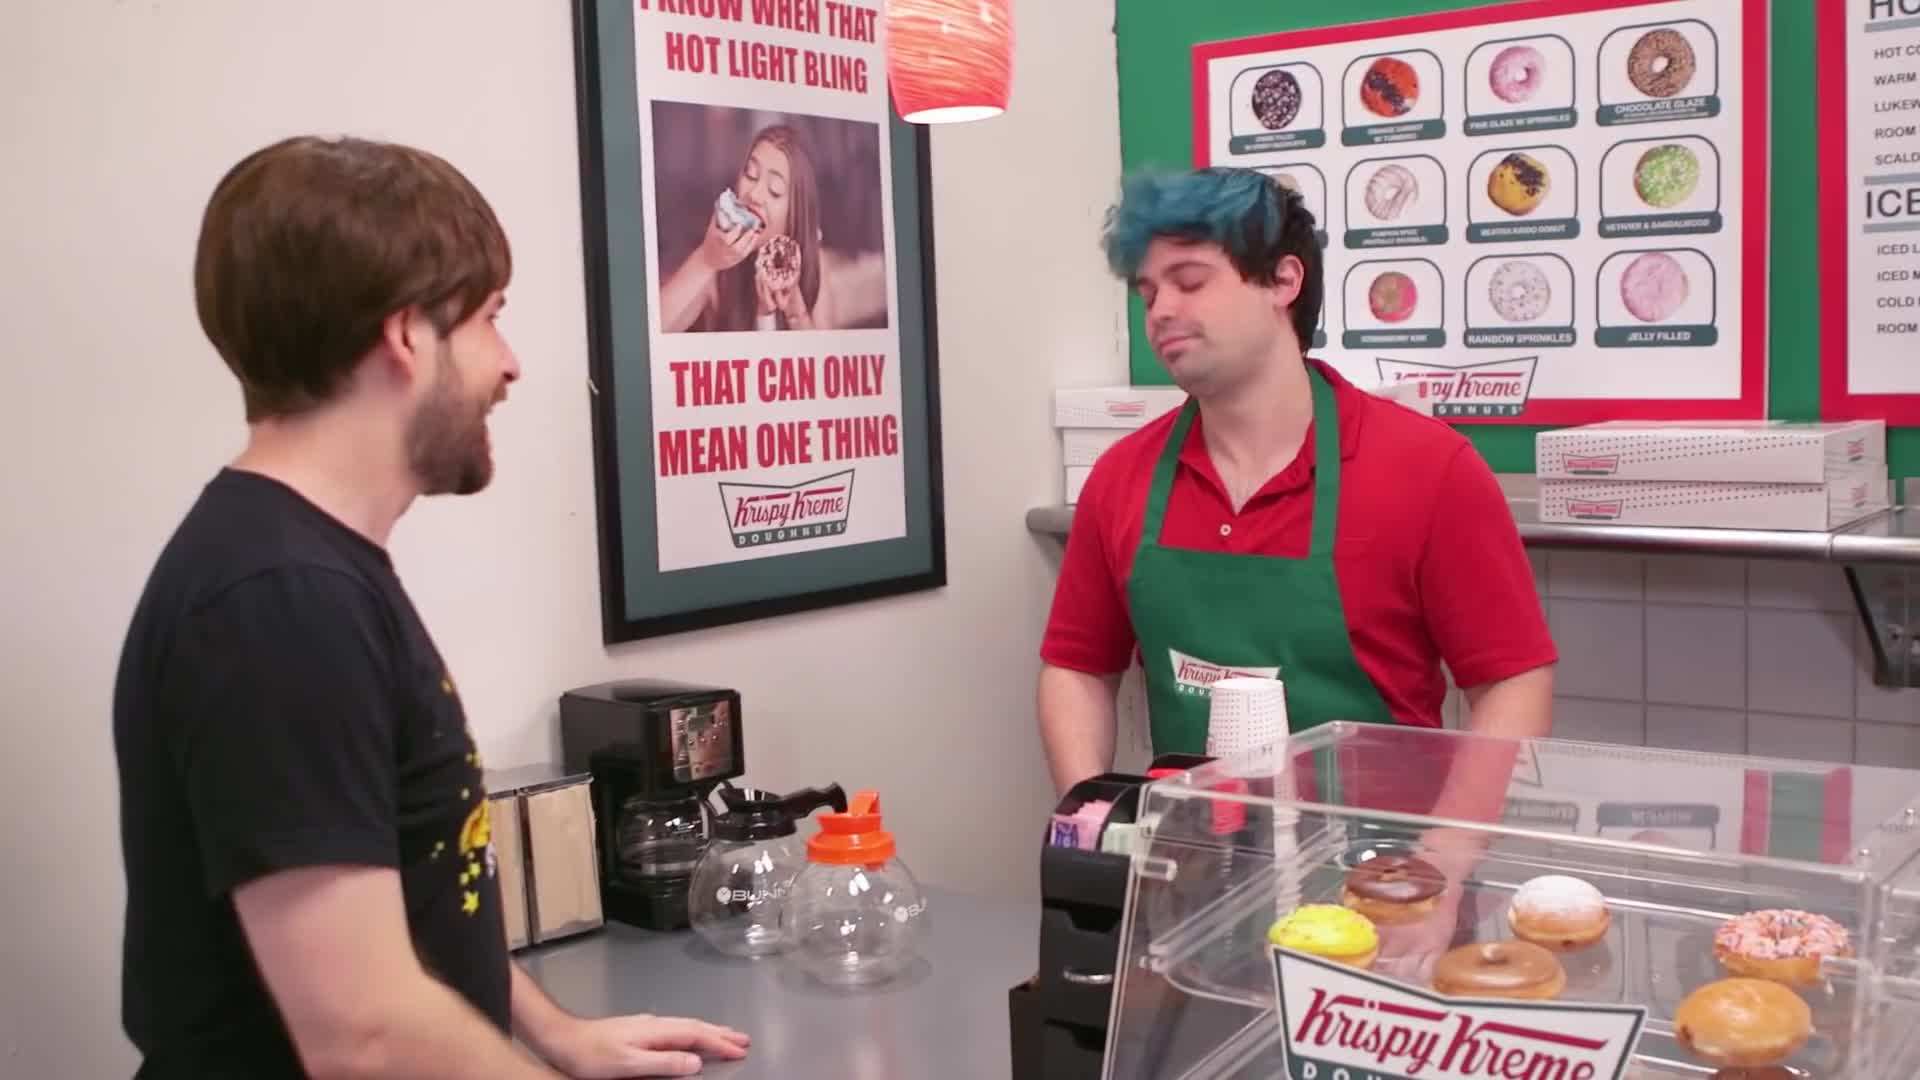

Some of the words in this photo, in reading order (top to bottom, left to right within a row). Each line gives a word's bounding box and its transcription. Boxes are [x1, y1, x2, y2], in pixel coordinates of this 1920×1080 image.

[751, 0, 820, 35] WHEN
[825, 5, 878, 44] THAT
[1873, 46, 1902, 59] HOT
[665, 31, 721, 75] HOT
[728, 39, 799, 84] LIGHT
[804, 51, 868, 94] BLING
[1874, 72, 1917, 86] WARM
[1614, 99, 1672, 114] CHOCOLATE
[1673, 97, 1706, 109] GLAZE
[1874, 125, 1917, 139] ROOM
[1877, 243, 1909, 256] ICED
[1877, 270, 1909, 282] ICED
[1877, 295, 1915, 308] COLD
[1877, 322, 1918, 335] ROOM
[1468, 333, 1515, 345] RAINBOW
[1516, 332, 1573, 344] SPRINKLES
[1627, 331, 1655, 343] JELLY
[1656, 330, 1691, 342] FILLED
[669, 359, 750, 407] THAT
[757, 356, 816, 403] CAN
[823, 354, 885, 399] ONLY
[1455, 371, 1524, 398] Kreme
[1438, 404, 1519, 416] GHNUTS
[658, 425, 748, 478] MEAN
[756, 420, 812, 468] ONE
[817, 414, 898, 462] THING
[733, 493, 792, 528] Krispy
[791, 486, 846, 520] Kreme
[738, 523, 843, 546] DOUGHNUTS
[1295, 988, 1446, 1075] Krispy
[1439, 1014, 1607, 1080] Kreme
